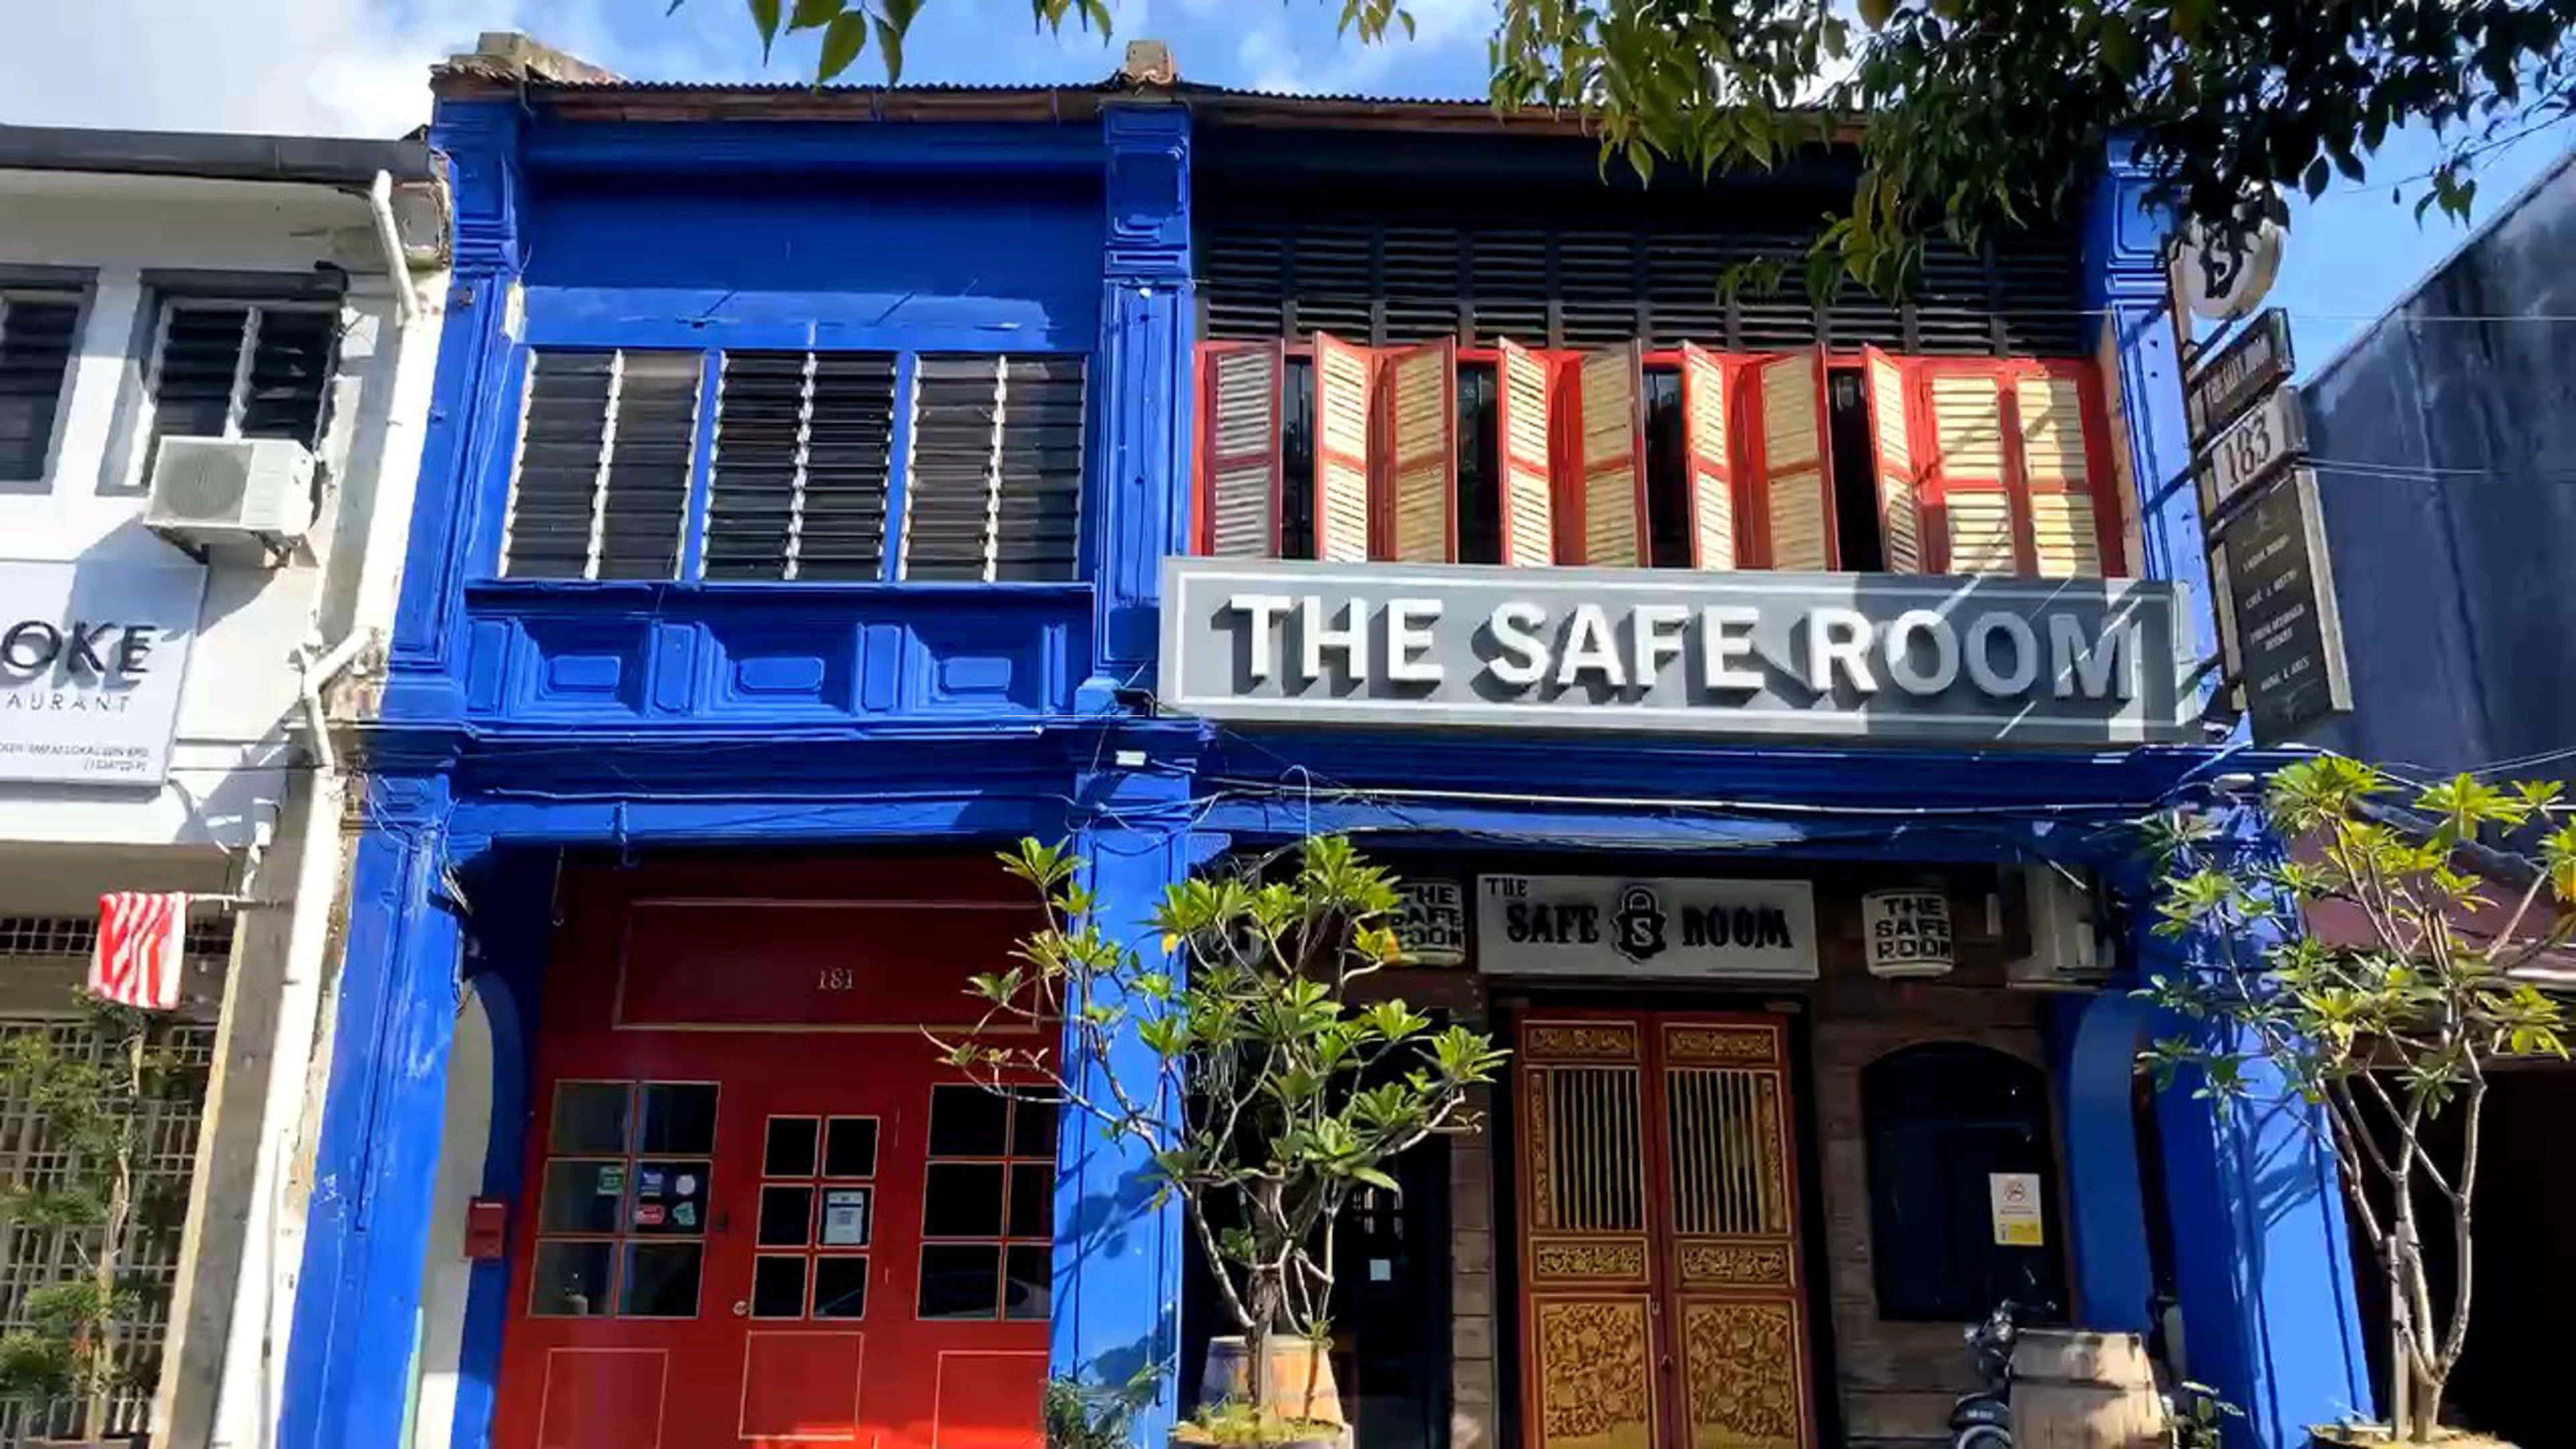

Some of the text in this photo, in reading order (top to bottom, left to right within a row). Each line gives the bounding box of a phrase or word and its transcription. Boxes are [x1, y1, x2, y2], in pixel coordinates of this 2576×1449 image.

[2222, 410, 2271, 487] 183
[1231, 594, 2141, 699] THE SAFE ROOM
[6, 692, 130, 711] AURANT
[1398, 885, 1454, 904] THE
[1485, 878, 1528, 898] THE
[1883, 898, 1941, 914] THE
[1507, 902, 1793, 949] SAFE ROOM
[1876, 918, 1949, 936] SAFE
[1877, 939, 1951, 959] ROOM
[817, 967, 853, 989] 181
